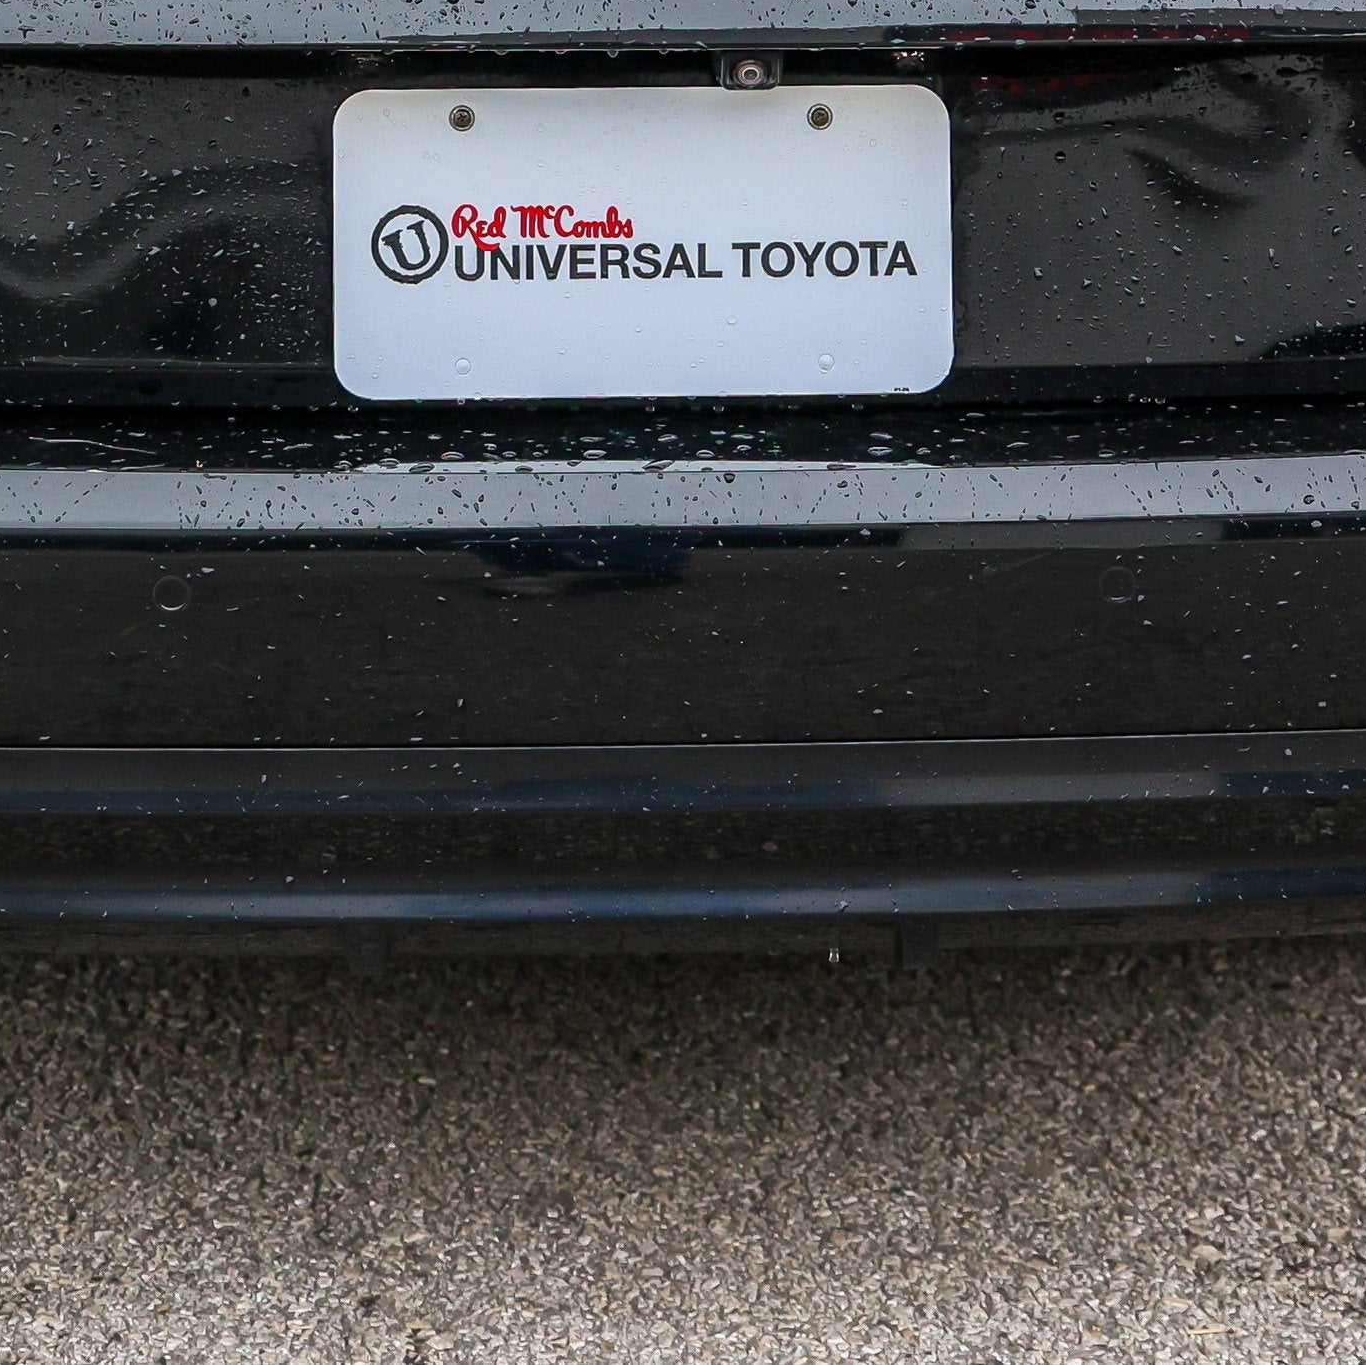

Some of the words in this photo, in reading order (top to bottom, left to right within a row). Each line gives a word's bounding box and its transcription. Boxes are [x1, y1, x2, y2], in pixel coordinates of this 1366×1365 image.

[451, 204, 507, 251] Red
[510, 205, 634, 239] McCombs
[454, 242, 723, 281] UNIVERSAL
[732, 240, 918, 278] TOYOTA
